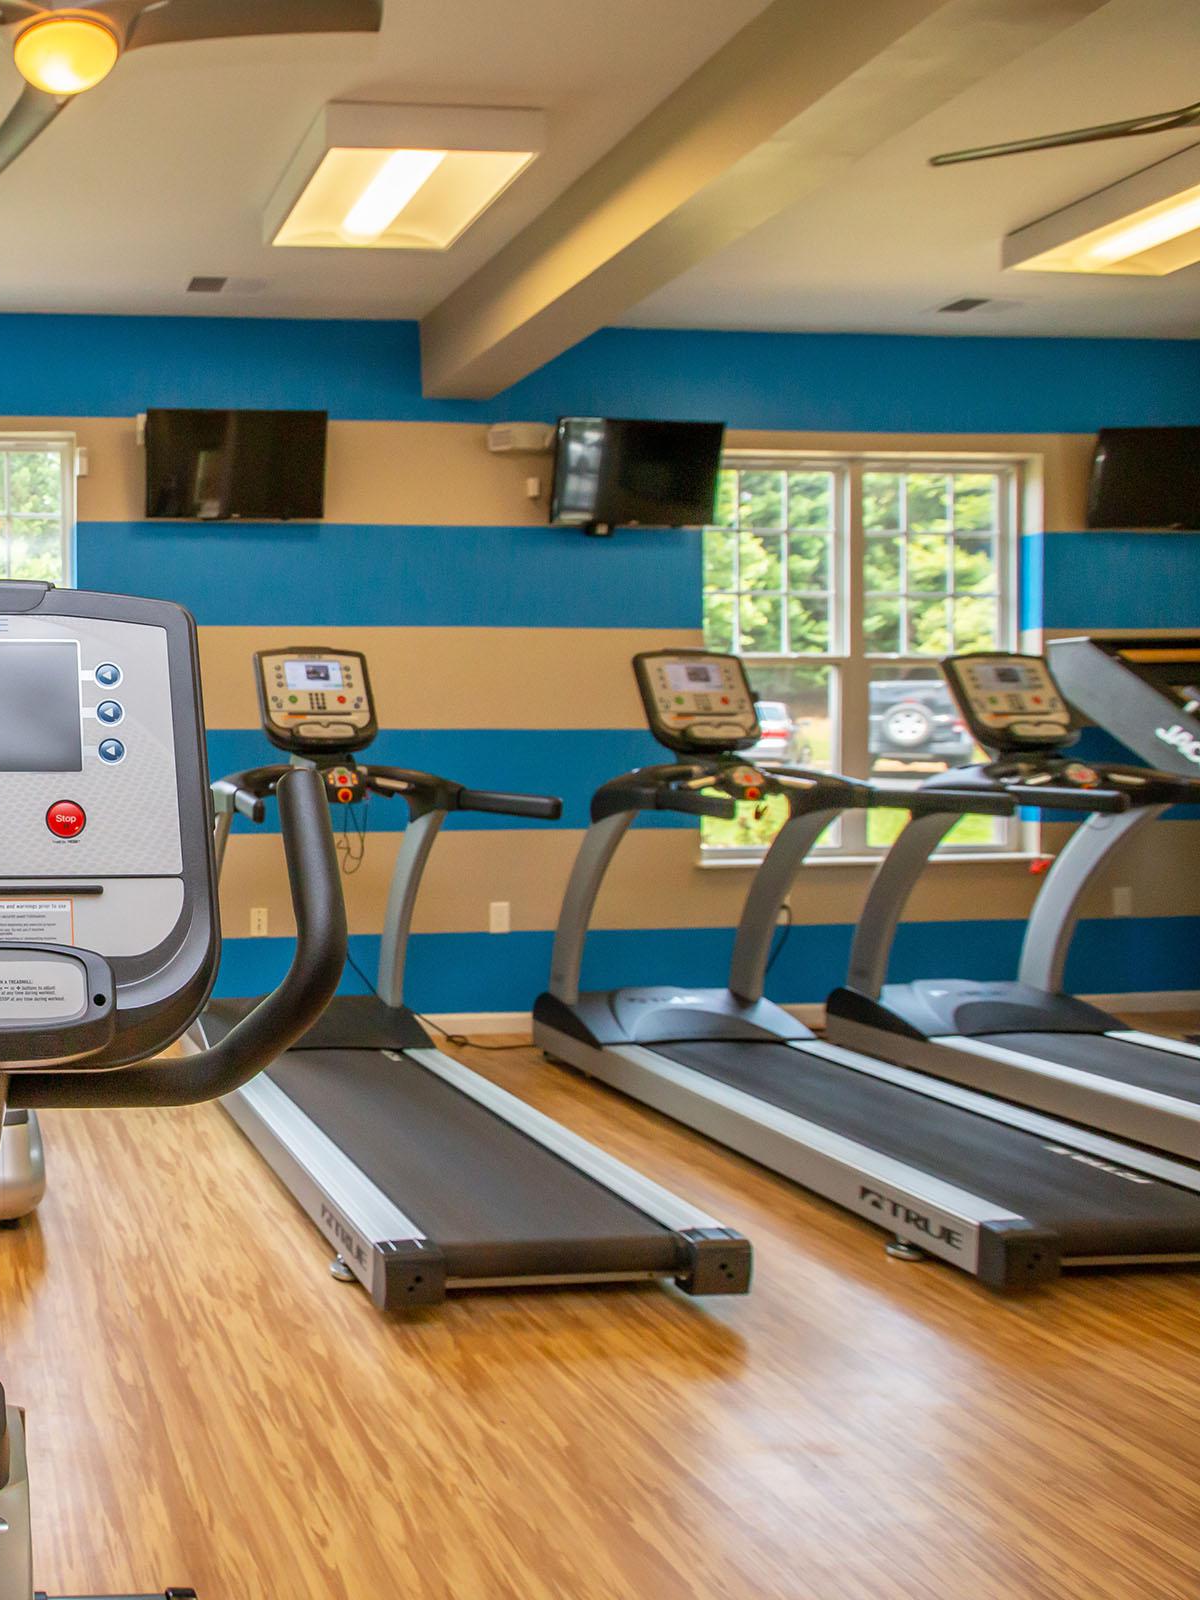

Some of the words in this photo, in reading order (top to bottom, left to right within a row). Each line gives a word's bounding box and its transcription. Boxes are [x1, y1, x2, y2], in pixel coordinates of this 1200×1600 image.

[55, 814, 77, 824] Stop
[38, 903, 50, 911] prior
[887, 1198, 963, 1250] TRUE
